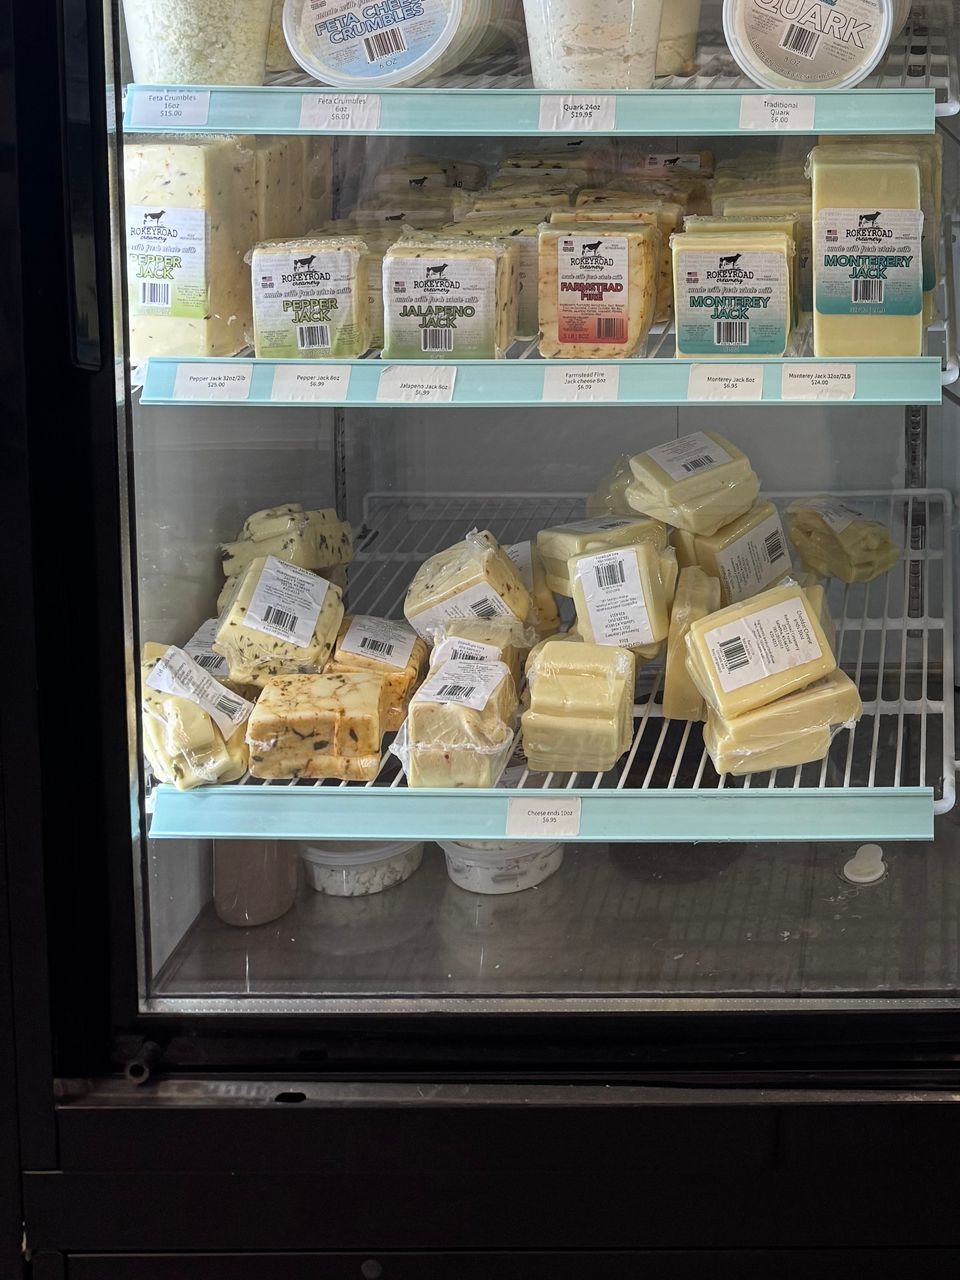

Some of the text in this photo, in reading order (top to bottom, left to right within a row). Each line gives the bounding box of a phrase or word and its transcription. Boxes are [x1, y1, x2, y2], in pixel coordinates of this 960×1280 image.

[314, 15, 356, 36] FETA
[330, 4, 425, 45] CRUMBLES
[130, 228, 178, 238] ROKEYROAD
[846, 229, 893, 238] ROKEYROAD
[570, 257, 614, 266] ROKEYROAD
[824, 255, 913, 268] MONTERERY
[136, 266, 174, 280] JACK
[282, 272, 331, 284] ROKEYROAD
[706, 271, 754, 280] ROKEYROAD
[849, 266, 888, 280] JACK
[414, 279, 460, 288] ROKEYROAD
[560, 282, 623, 292] FARMSTEAD
[283, 298, 338, 312] PEPPER
[690, 296, 770, 308] MONTEREY
[292, 310, 332, 324] JACK
[400, 305, 476, 318] JALAPENO
[711, 307, 749, 320] JACK
[419, 316, 457, 329] JACK
